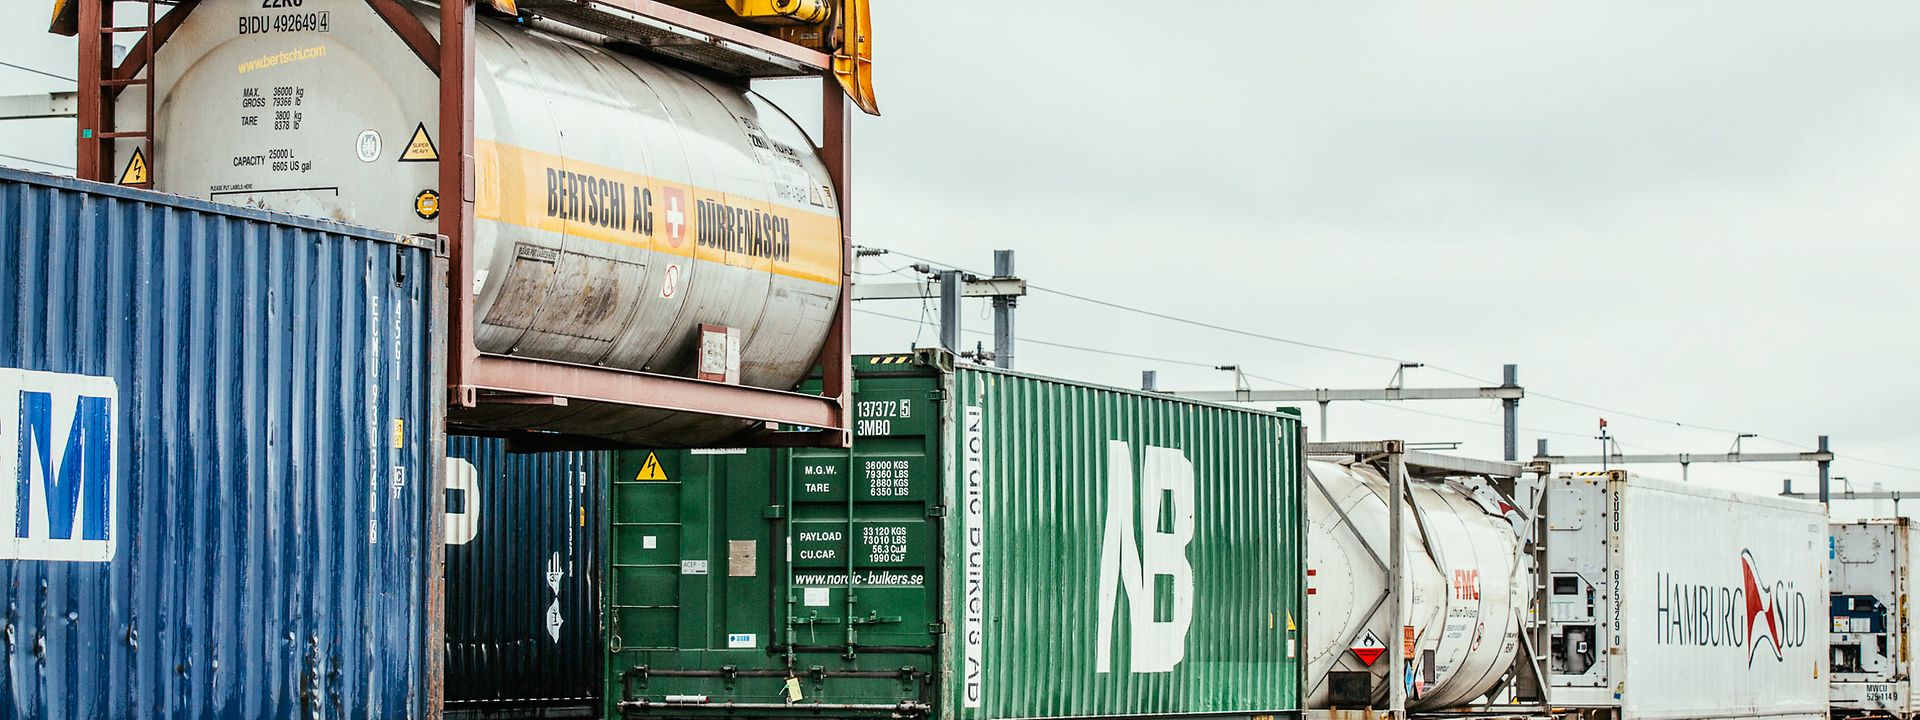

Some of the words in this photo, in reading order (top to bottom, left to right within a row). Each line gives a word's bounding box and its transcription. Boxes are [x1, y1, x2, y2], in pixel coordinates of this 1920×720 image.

[239, 16, 270, 34] BIDU
[274, 13, 316, 32] 492649
[319, 12, 328, 31] 4
[237, 45, 326, 74] www.bertschi.com
[243, 88, 260, 97] MAX.
[273, 87, 292, 96] 36000
[296, 87, 304, 98] kg
[242, 98, 266, 108] GROSS
[273, 97, 291, 106] 79366
[295, 97, 301, 106] lb
[242, 116, 258, 125] TARE
[275, 111, 290, 120] 3800
[294, 111, 302, 122] kg
[274, 121, 290, 130] 8378
[293, 120, 299, 129] lb
[269, 149, 288, 159] 25000
[290, 149, 294, 158] L
[233, 156, 265, 166] CAPACITY
[272, 162, 288, 171] 6605
[290, 161, 299, 171] US
[301, 161, 312, 173] gal
[547, 167, 625, 230] BERTSCHI
[632, 186, 652, 236] AG
[857, 401, 897, 417] 137372
[901, 400, 910, 417] 5
[805, 466, 837, 474] M.G.W.
[865, 461, 892, 469] 36000
[894, 461, 909, 469] KGS
[865, 470, 892, 478] 79360
[894, 470, 909, 478] LBS
[805, 483, 830, 492] TARE
[871, 479, 892, 487] 2880
[894, 479, 909, 487] KGS
[871, 488, 892, 496] 6350
[894, 488, 909, 496] LBS
[863, 527, 889, 535] 33120
[891, 527, 906, 535] KGS
[800, 532, 842, 541] PAYLOAD
[863, 536, 889, 544] 73010
[892, 536, 906, 544] LBS
[872, 545, 889, 553] 56.3
[800, 550, 836, 559] CU.CAP.
[870, 554, 889, 562] 1990
[1096, 440, 1194, 673] NB
[1454, 569, 1479, 600] FMC
[1657, 572, 1743, 647] HAMBURG
[1775, 580, 1806, 649] SÜD
